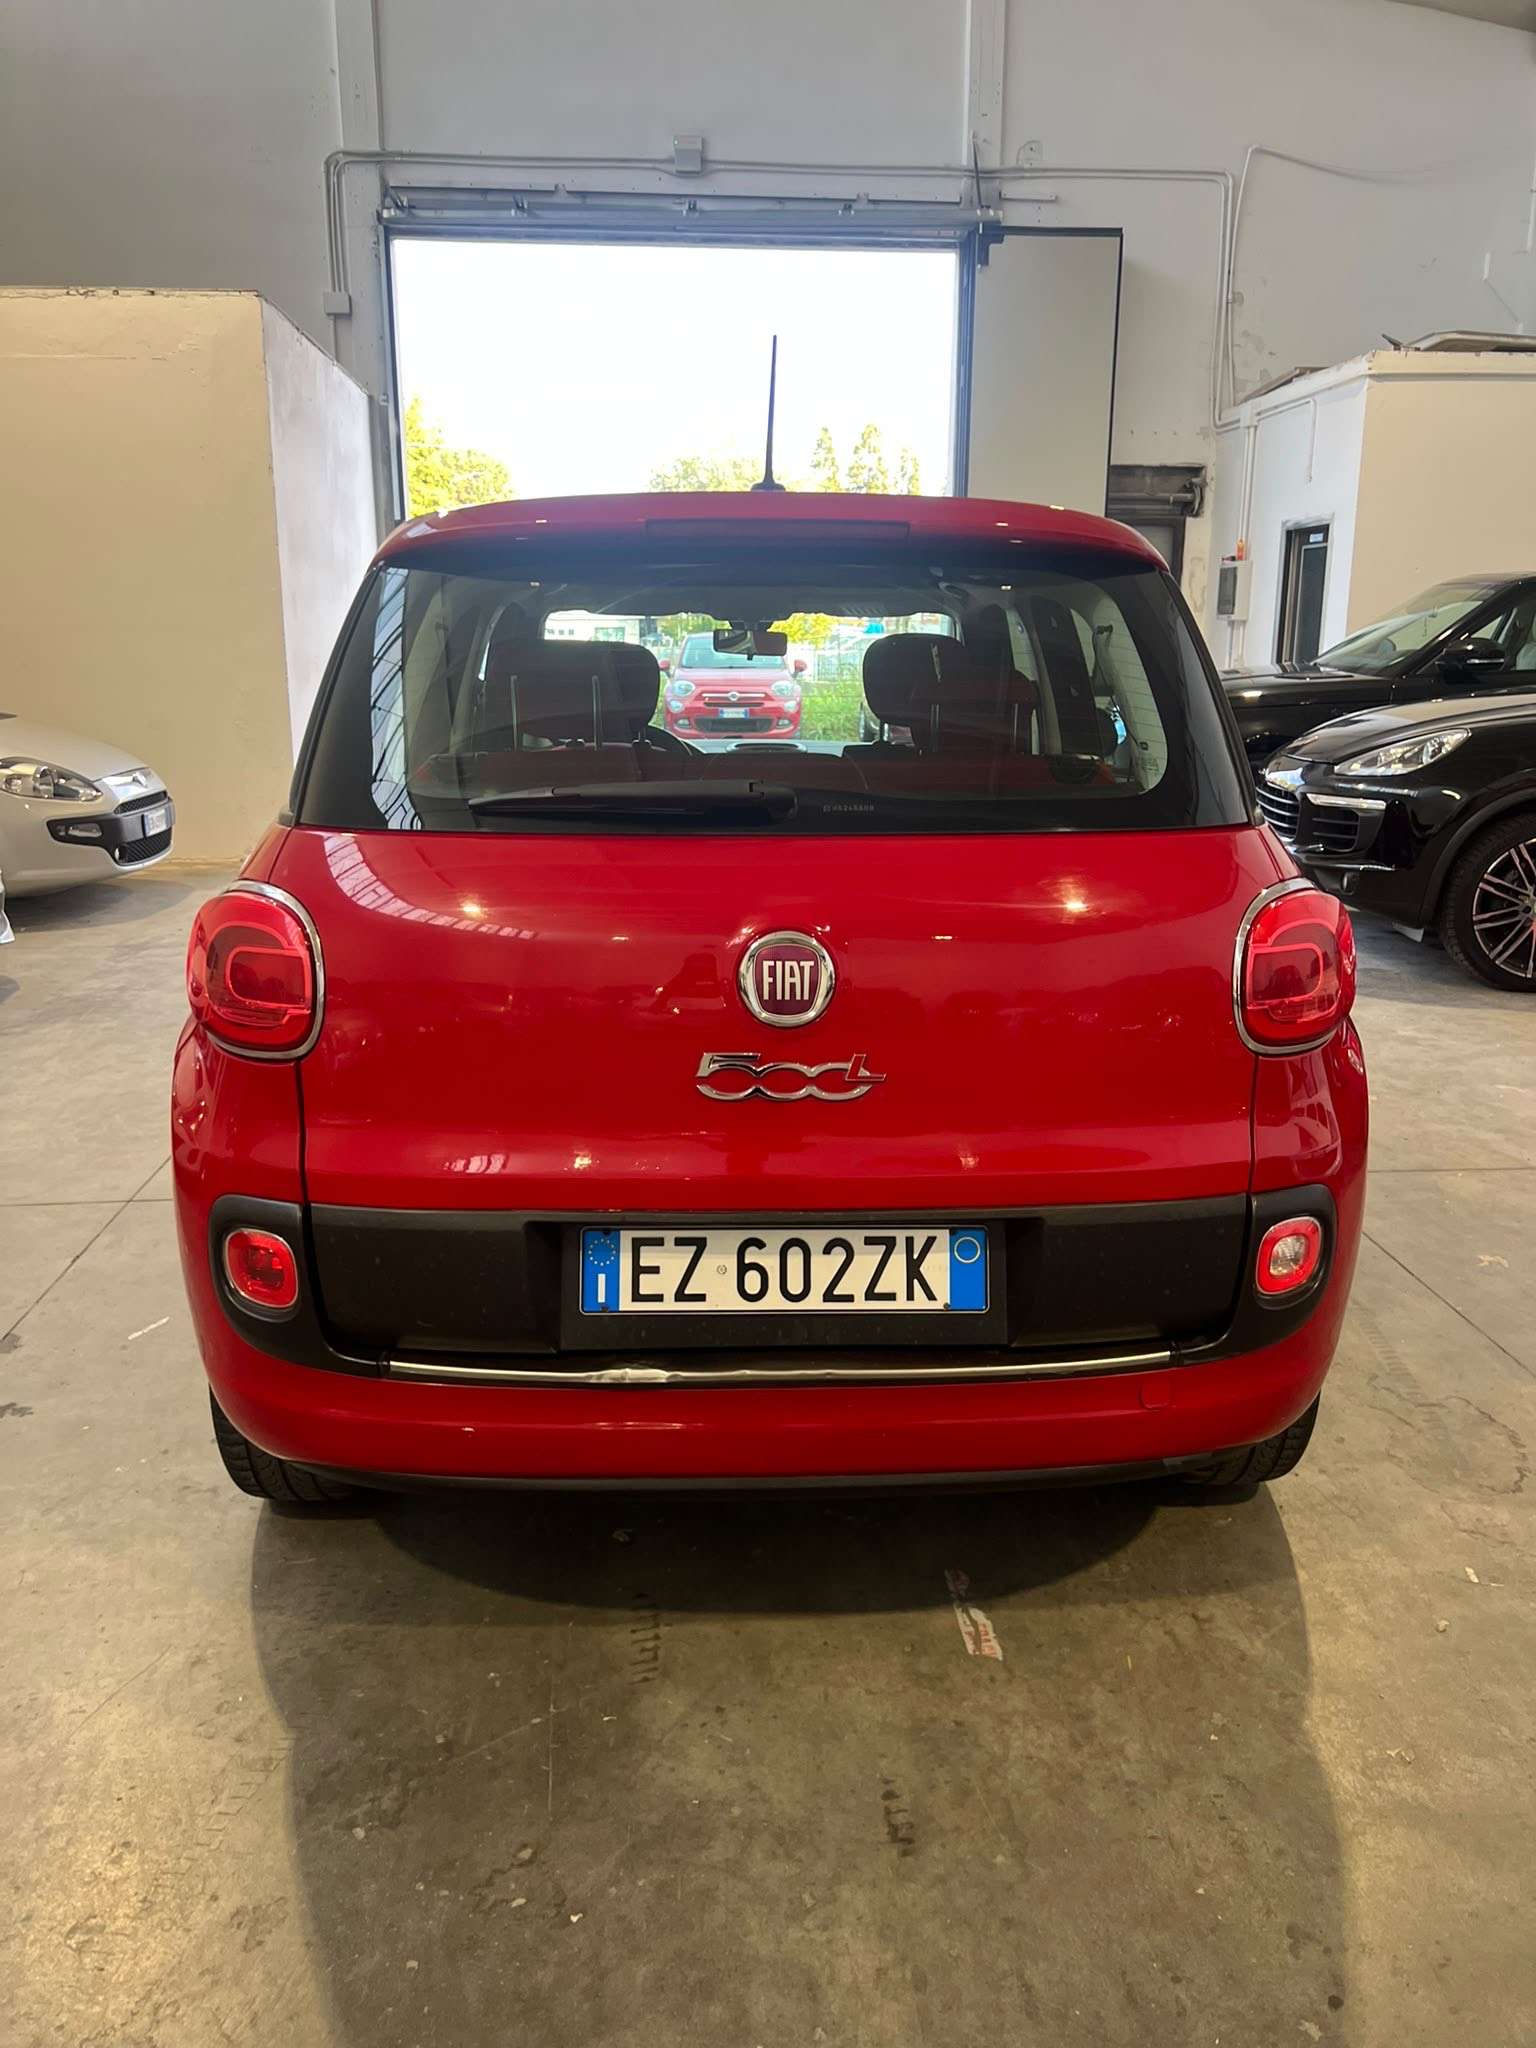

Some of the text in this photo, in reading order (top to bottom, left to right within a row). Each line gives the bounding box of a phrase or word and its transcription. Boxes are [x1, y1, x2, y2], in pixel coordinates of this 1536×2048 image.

[762, 960, 814, 1001] FIAT
[597, 1235, 938, 1304] I EZ 602ZK
